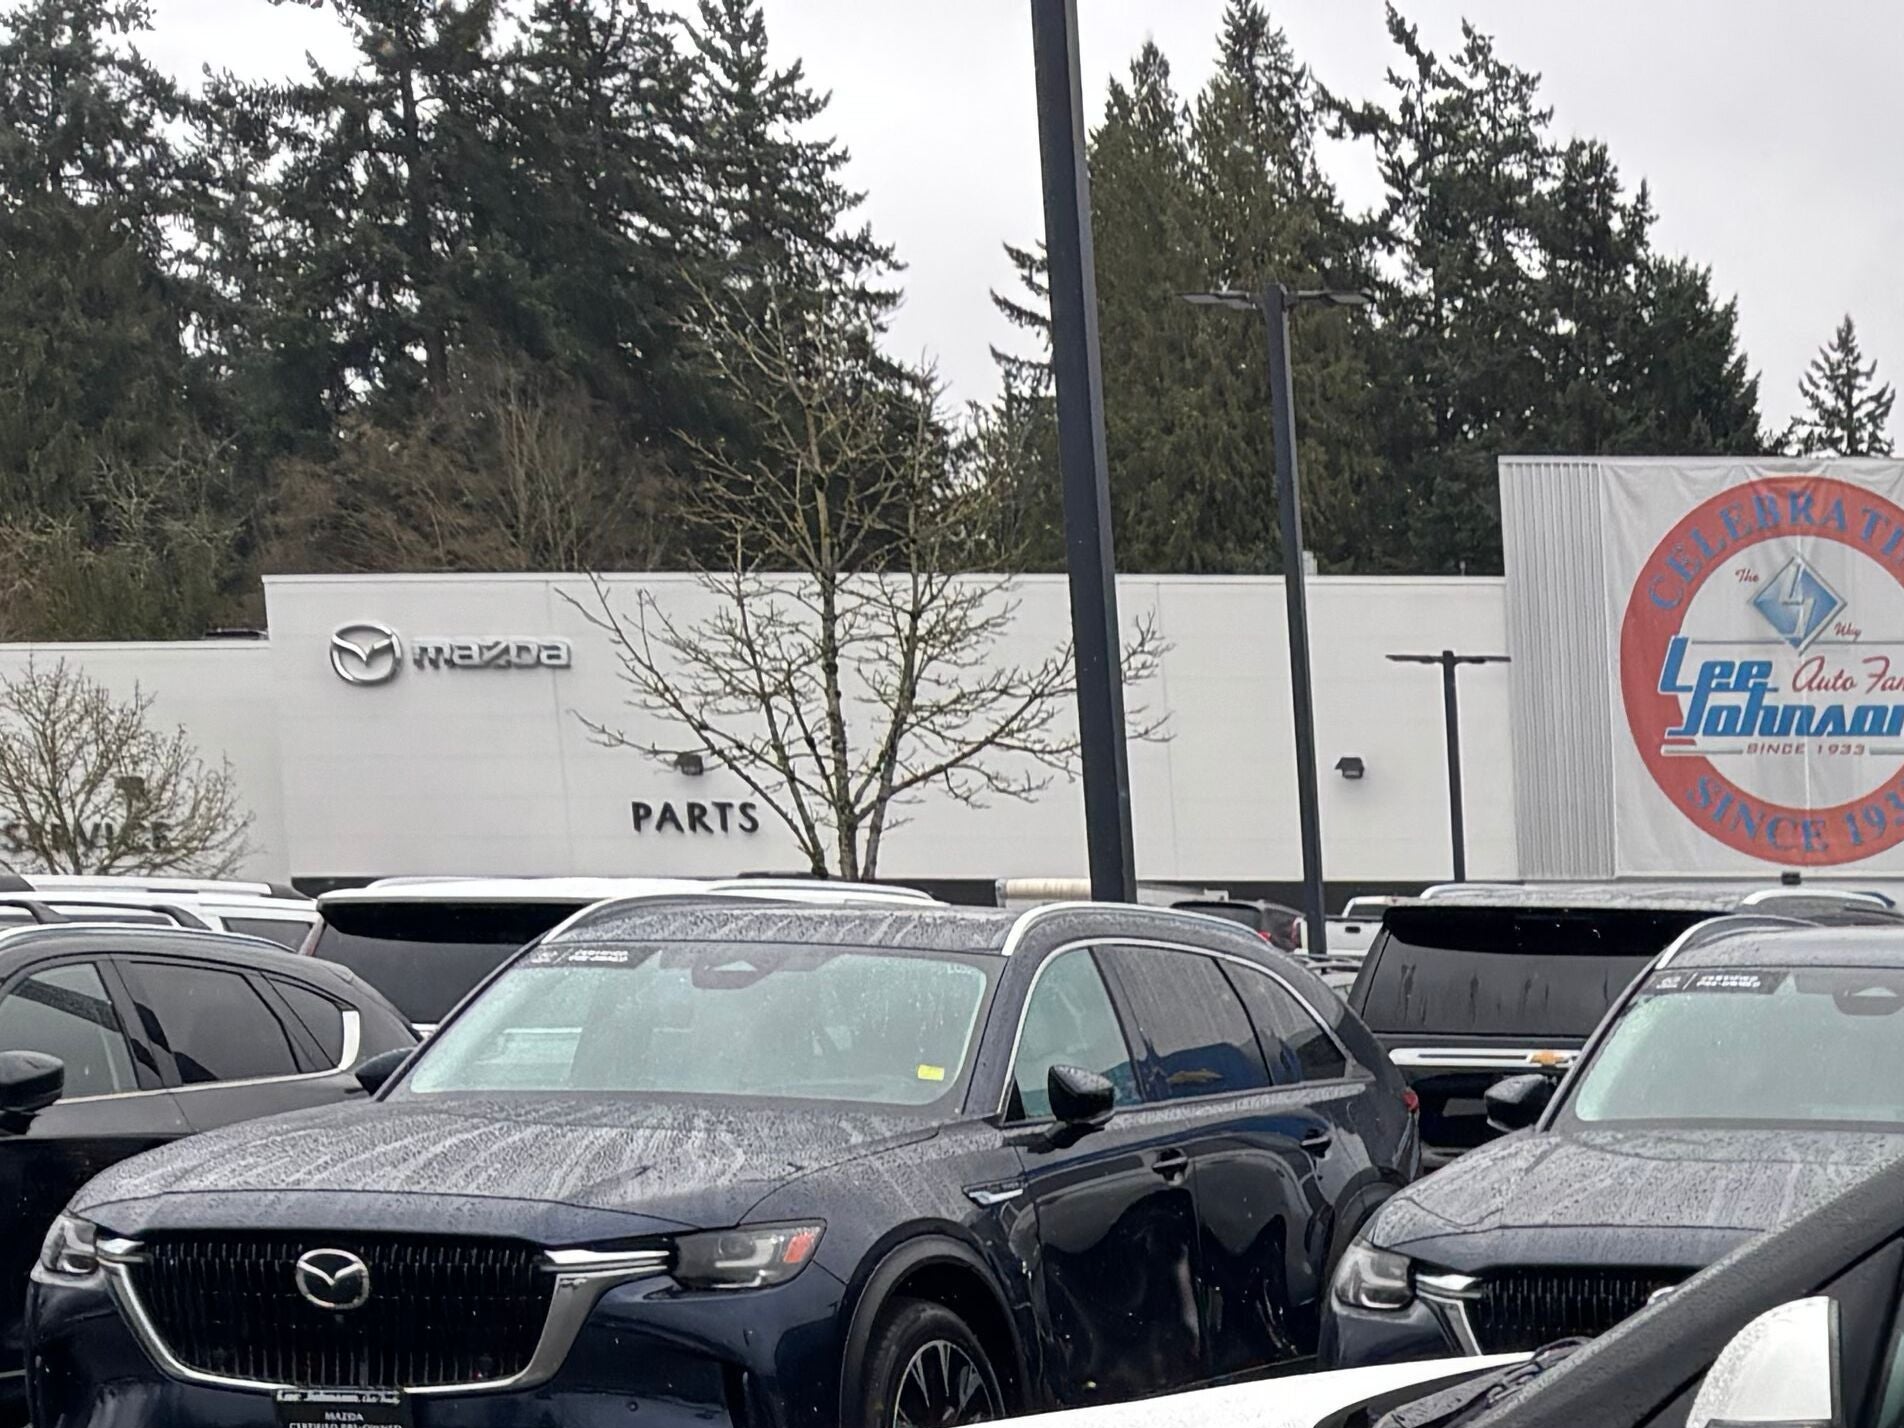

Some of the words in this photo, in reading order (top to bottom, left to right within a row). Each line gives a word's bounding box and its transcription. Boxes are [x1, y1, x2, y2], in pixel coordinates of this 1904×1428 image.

[1735, 567, 1760, 584] The
[1833, 622, 1862, 642] Way
[1659, 635, 1780, 694] Lee
[1790, 655, 1858, 694] Auto
[1746, 742, 1806, 755] SINCE
[1816, 743, 1866, 755] 1933
[631, 801, 761, 835] PARTS
[1685, 775, 1830, 852] SINCE
[324, 1411, 364, 1422] MAZDA
